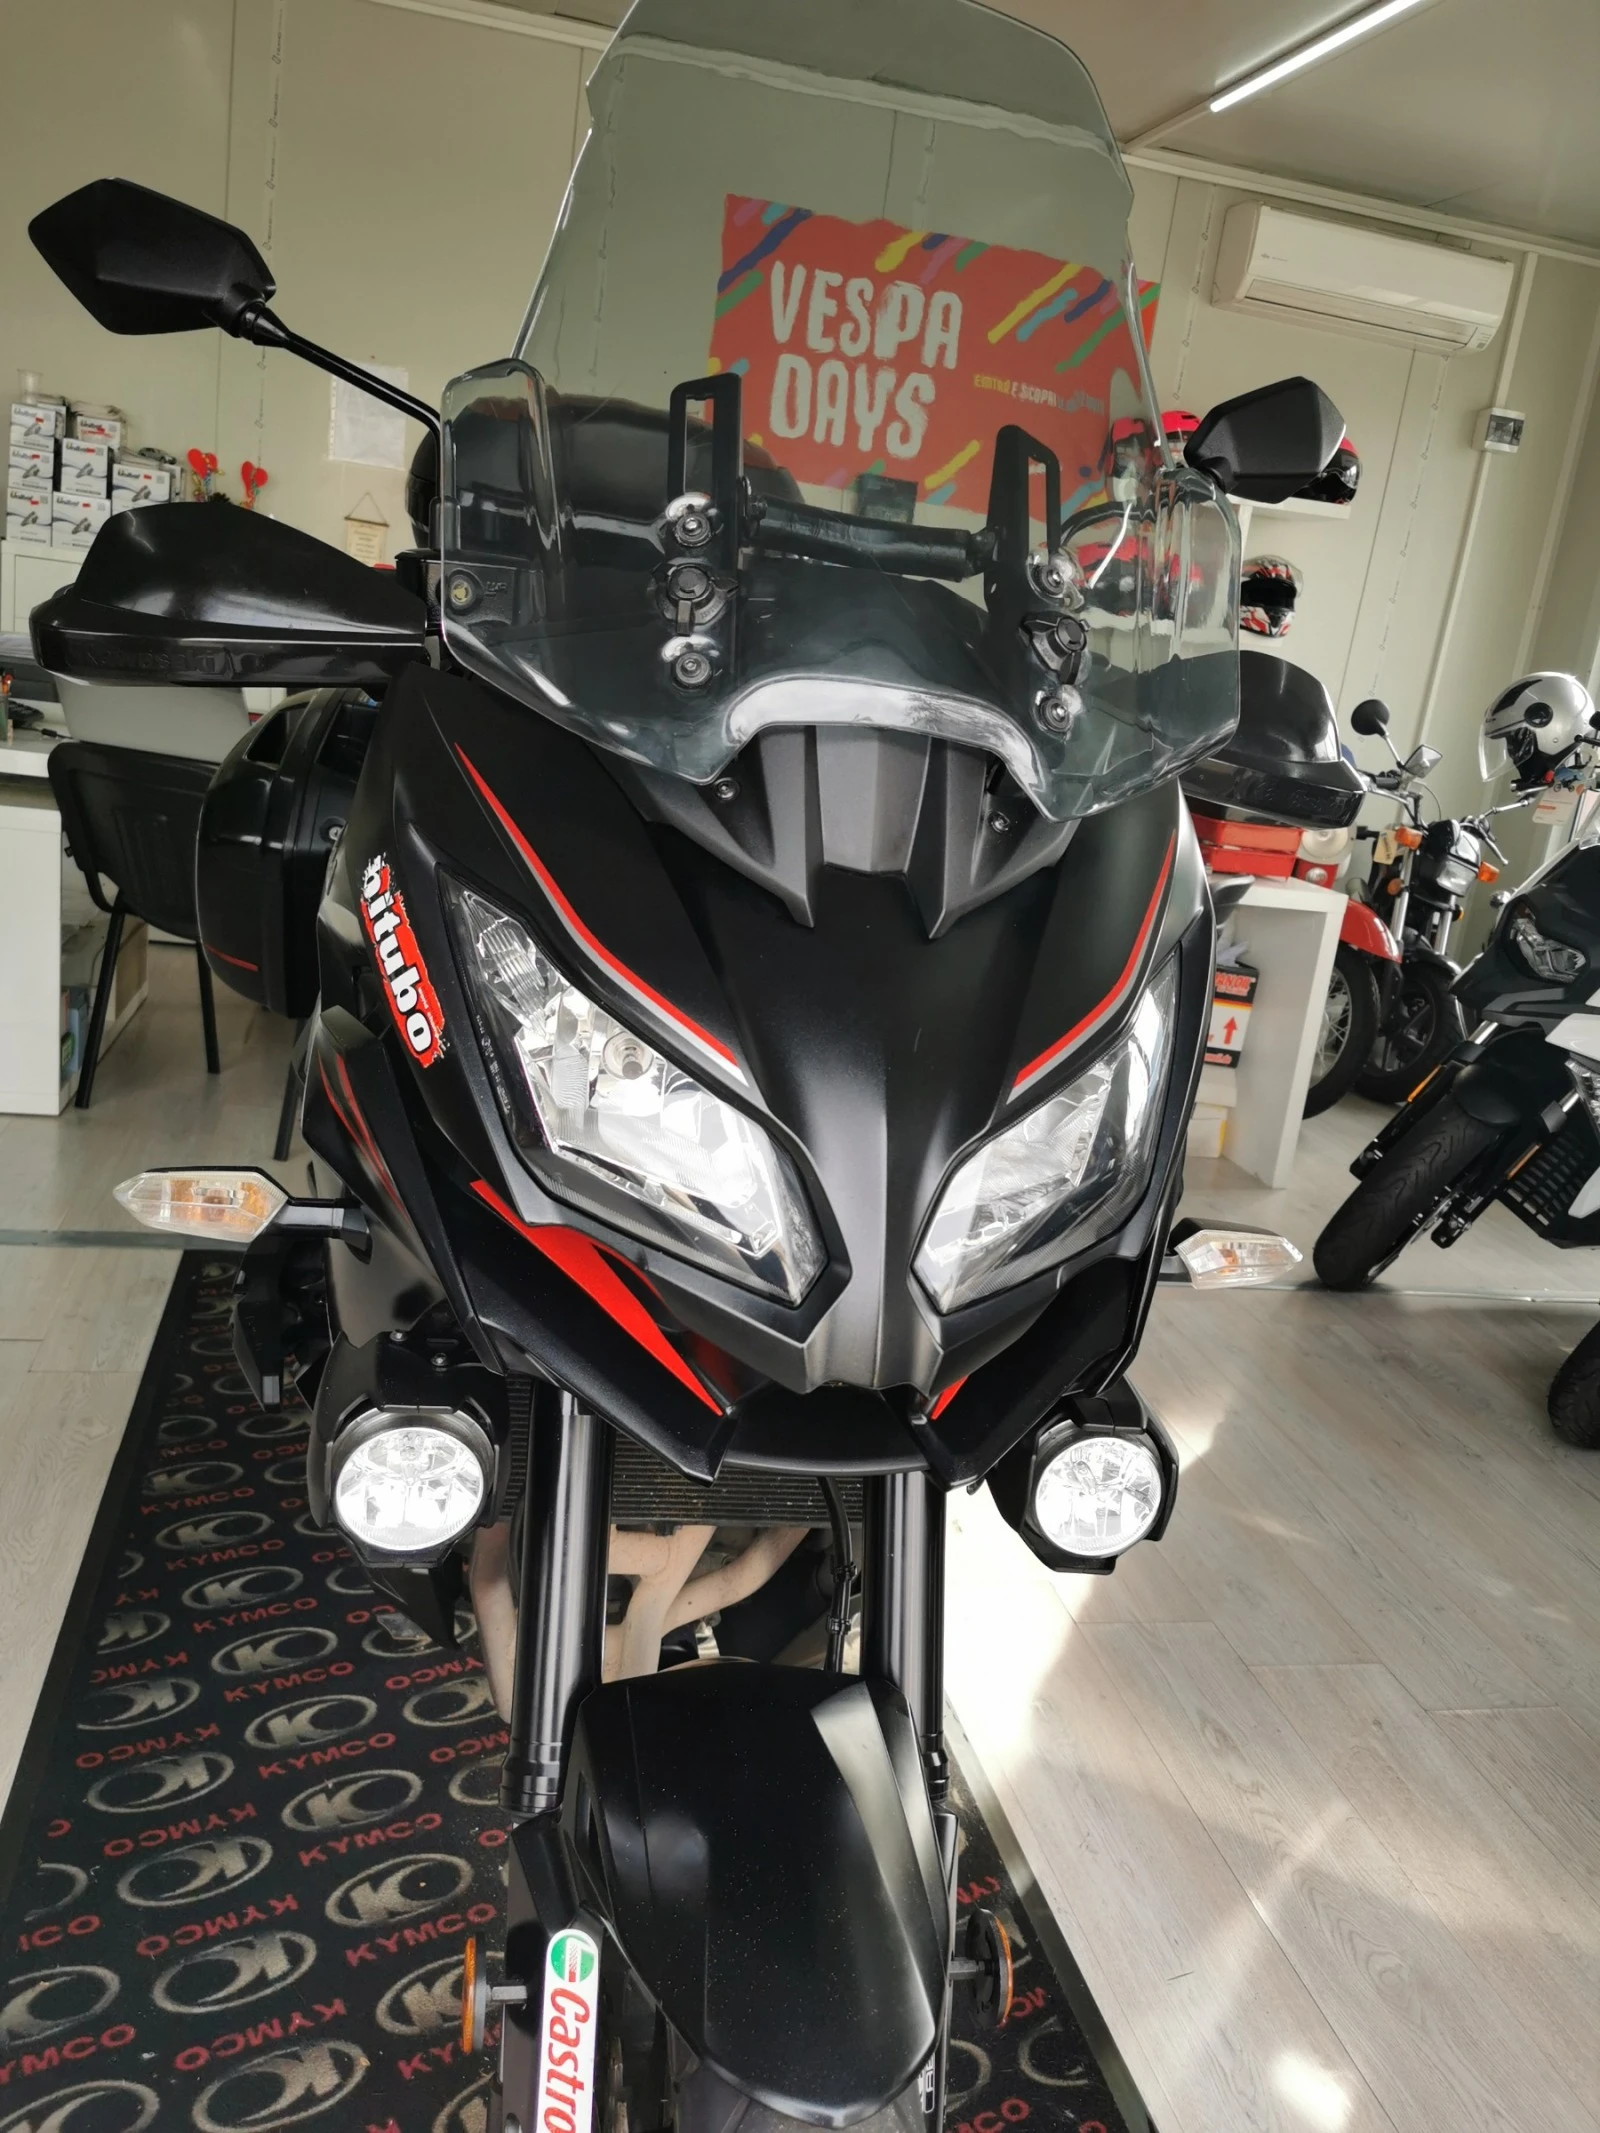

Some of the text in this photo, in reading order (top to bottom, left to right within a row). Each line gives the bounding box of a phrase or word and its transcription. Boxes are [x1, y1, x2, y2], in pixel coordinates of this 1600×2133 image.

[770, 260, 963, 370] VESPA
[769, 353, 936, 460] DAYS
[141, 1487, 255, 1514] KYMCO
[165, 1539, 285, 1571] KYMCO
[192, 1597, 318, 1633] KYMCO
[90, 1650, 189, 1685] KYMC
[224, 1662, 354, 1703] KYMCO
[385, 1656, 484, 1690] YMCO
[76, 1723, 220, 1769] KYMCO
[258, 1732, 397, 1780] KYMCO
[103, 1803, 258, 1857] KYMCO
[298, 1812, 443, 1867] KYMCO
[136, 1893, 299, 1957] KYMCO
[344, 1902, 497, 1968] KYMCO
[0, 2023, 136, 2086] YMCO
[173, 1998, 348, 2072] KYMCO
[543, 1987, 590, 2133] Castro
